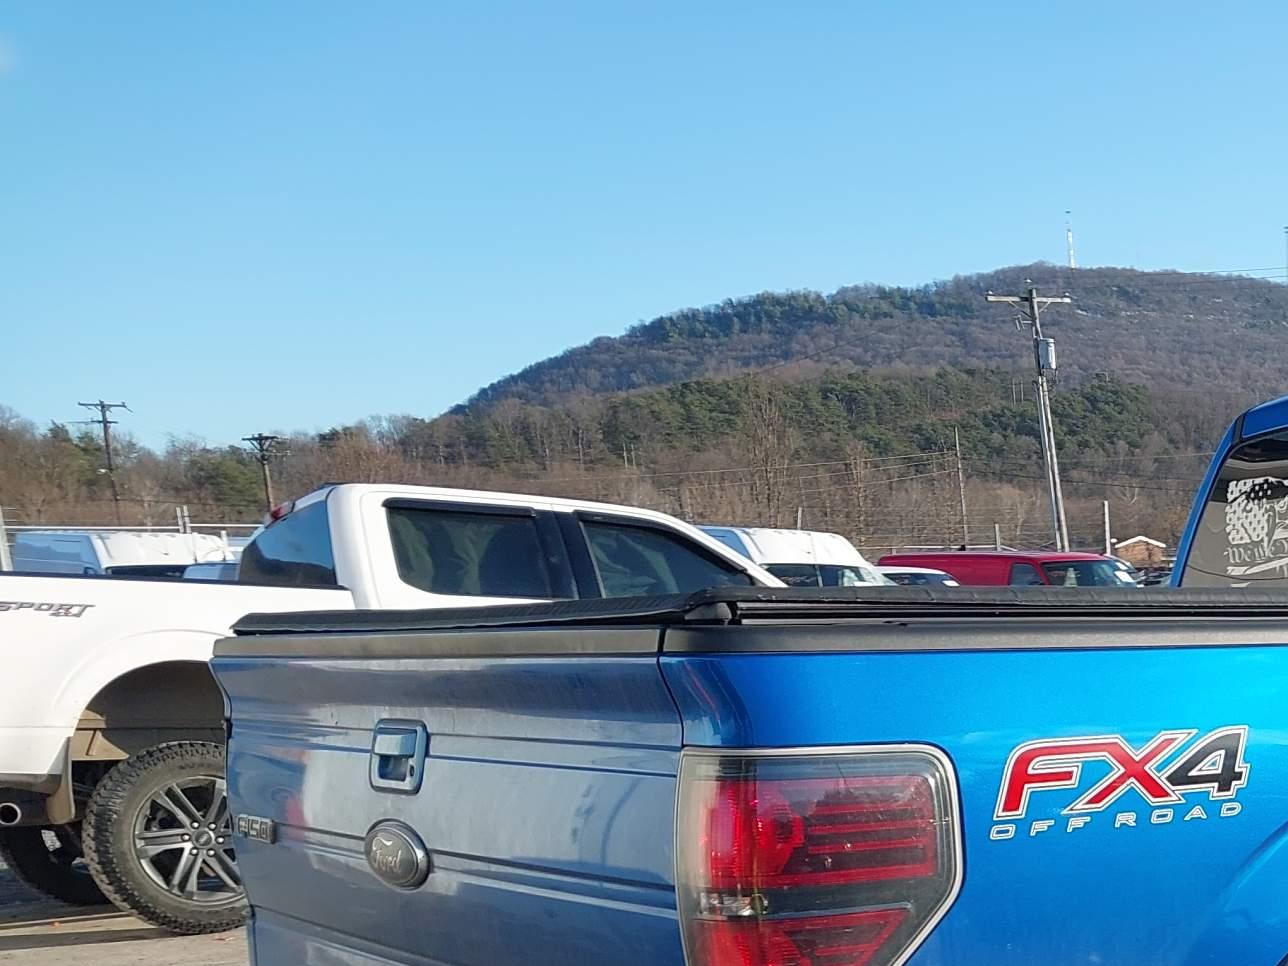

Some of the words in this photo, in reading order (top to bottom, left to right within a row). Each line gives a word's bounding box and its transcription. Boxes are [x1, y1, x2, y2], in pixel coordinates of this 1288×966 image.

[993, 725, 1250, 820] FX4
[990, 816, 1092, 840] OFF
[1114, 802, 1242, 828] ROAD
